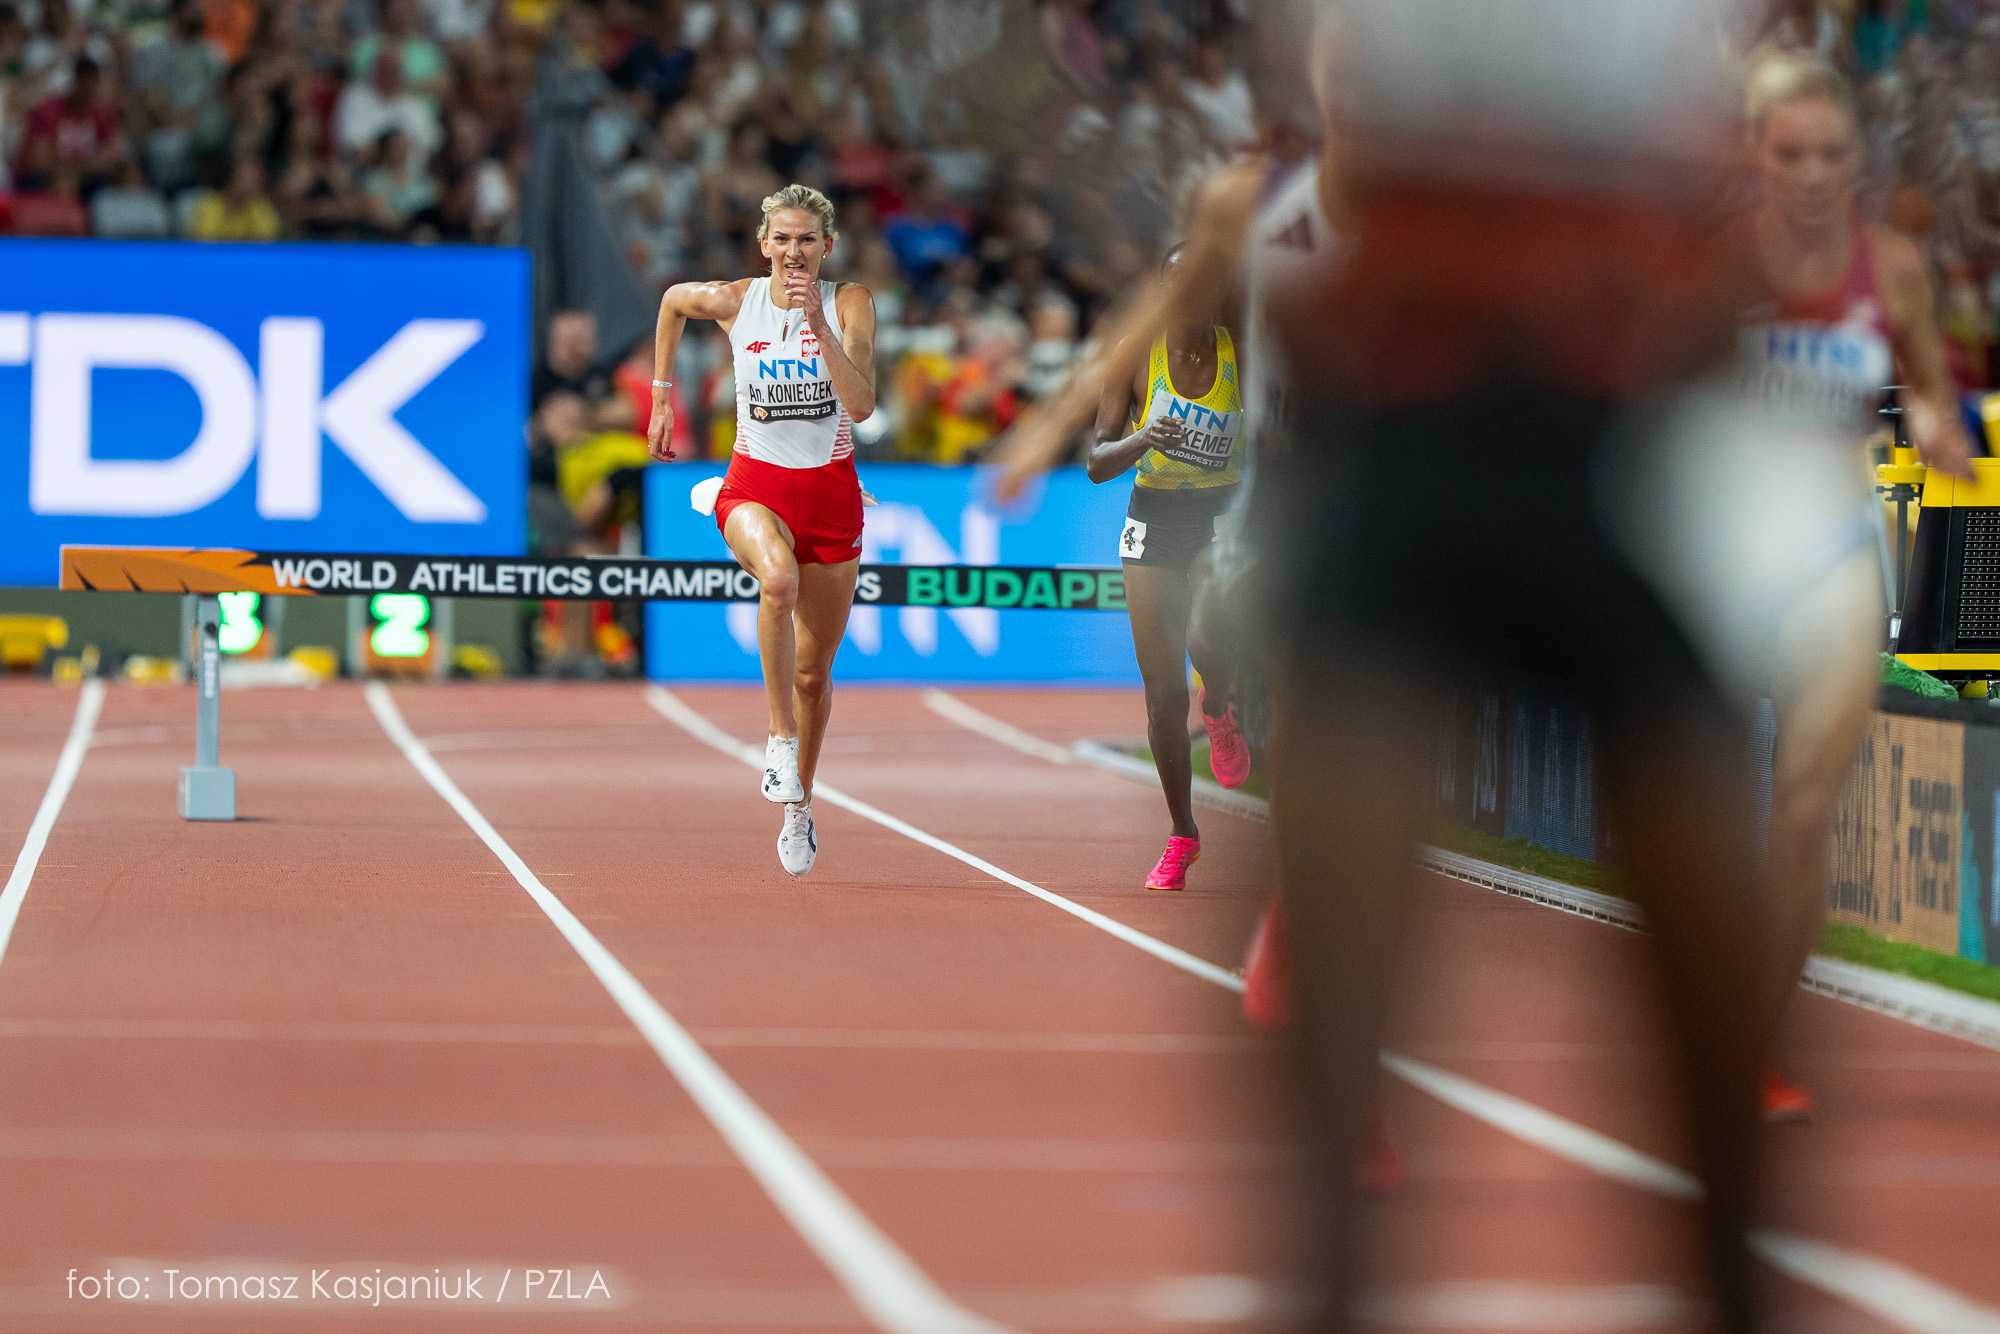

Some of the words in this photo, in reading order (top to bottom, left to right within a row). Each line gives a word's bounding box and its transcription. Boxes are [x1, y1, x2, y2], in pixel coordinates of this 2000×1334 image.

[746, 341, 771, 353] 4F
[759, 358, 818, 380] NTN
[749, 383, 765, 403] An.
[767, 380, 833, 403] KONIECZEK
[0, 311, 487, 524] DK
[770, 407, 821, 417] BUDAPEST
[822, 405, 831, 413] 23
[1168, 397, 1229, 433] NTN
[272, 559, 397, 590] WORLD
[409, 562, 593, 596] ATHLETICS
[907, 567, 1127, 610] BUDAPE
[370, 592, 431, 657] 2
